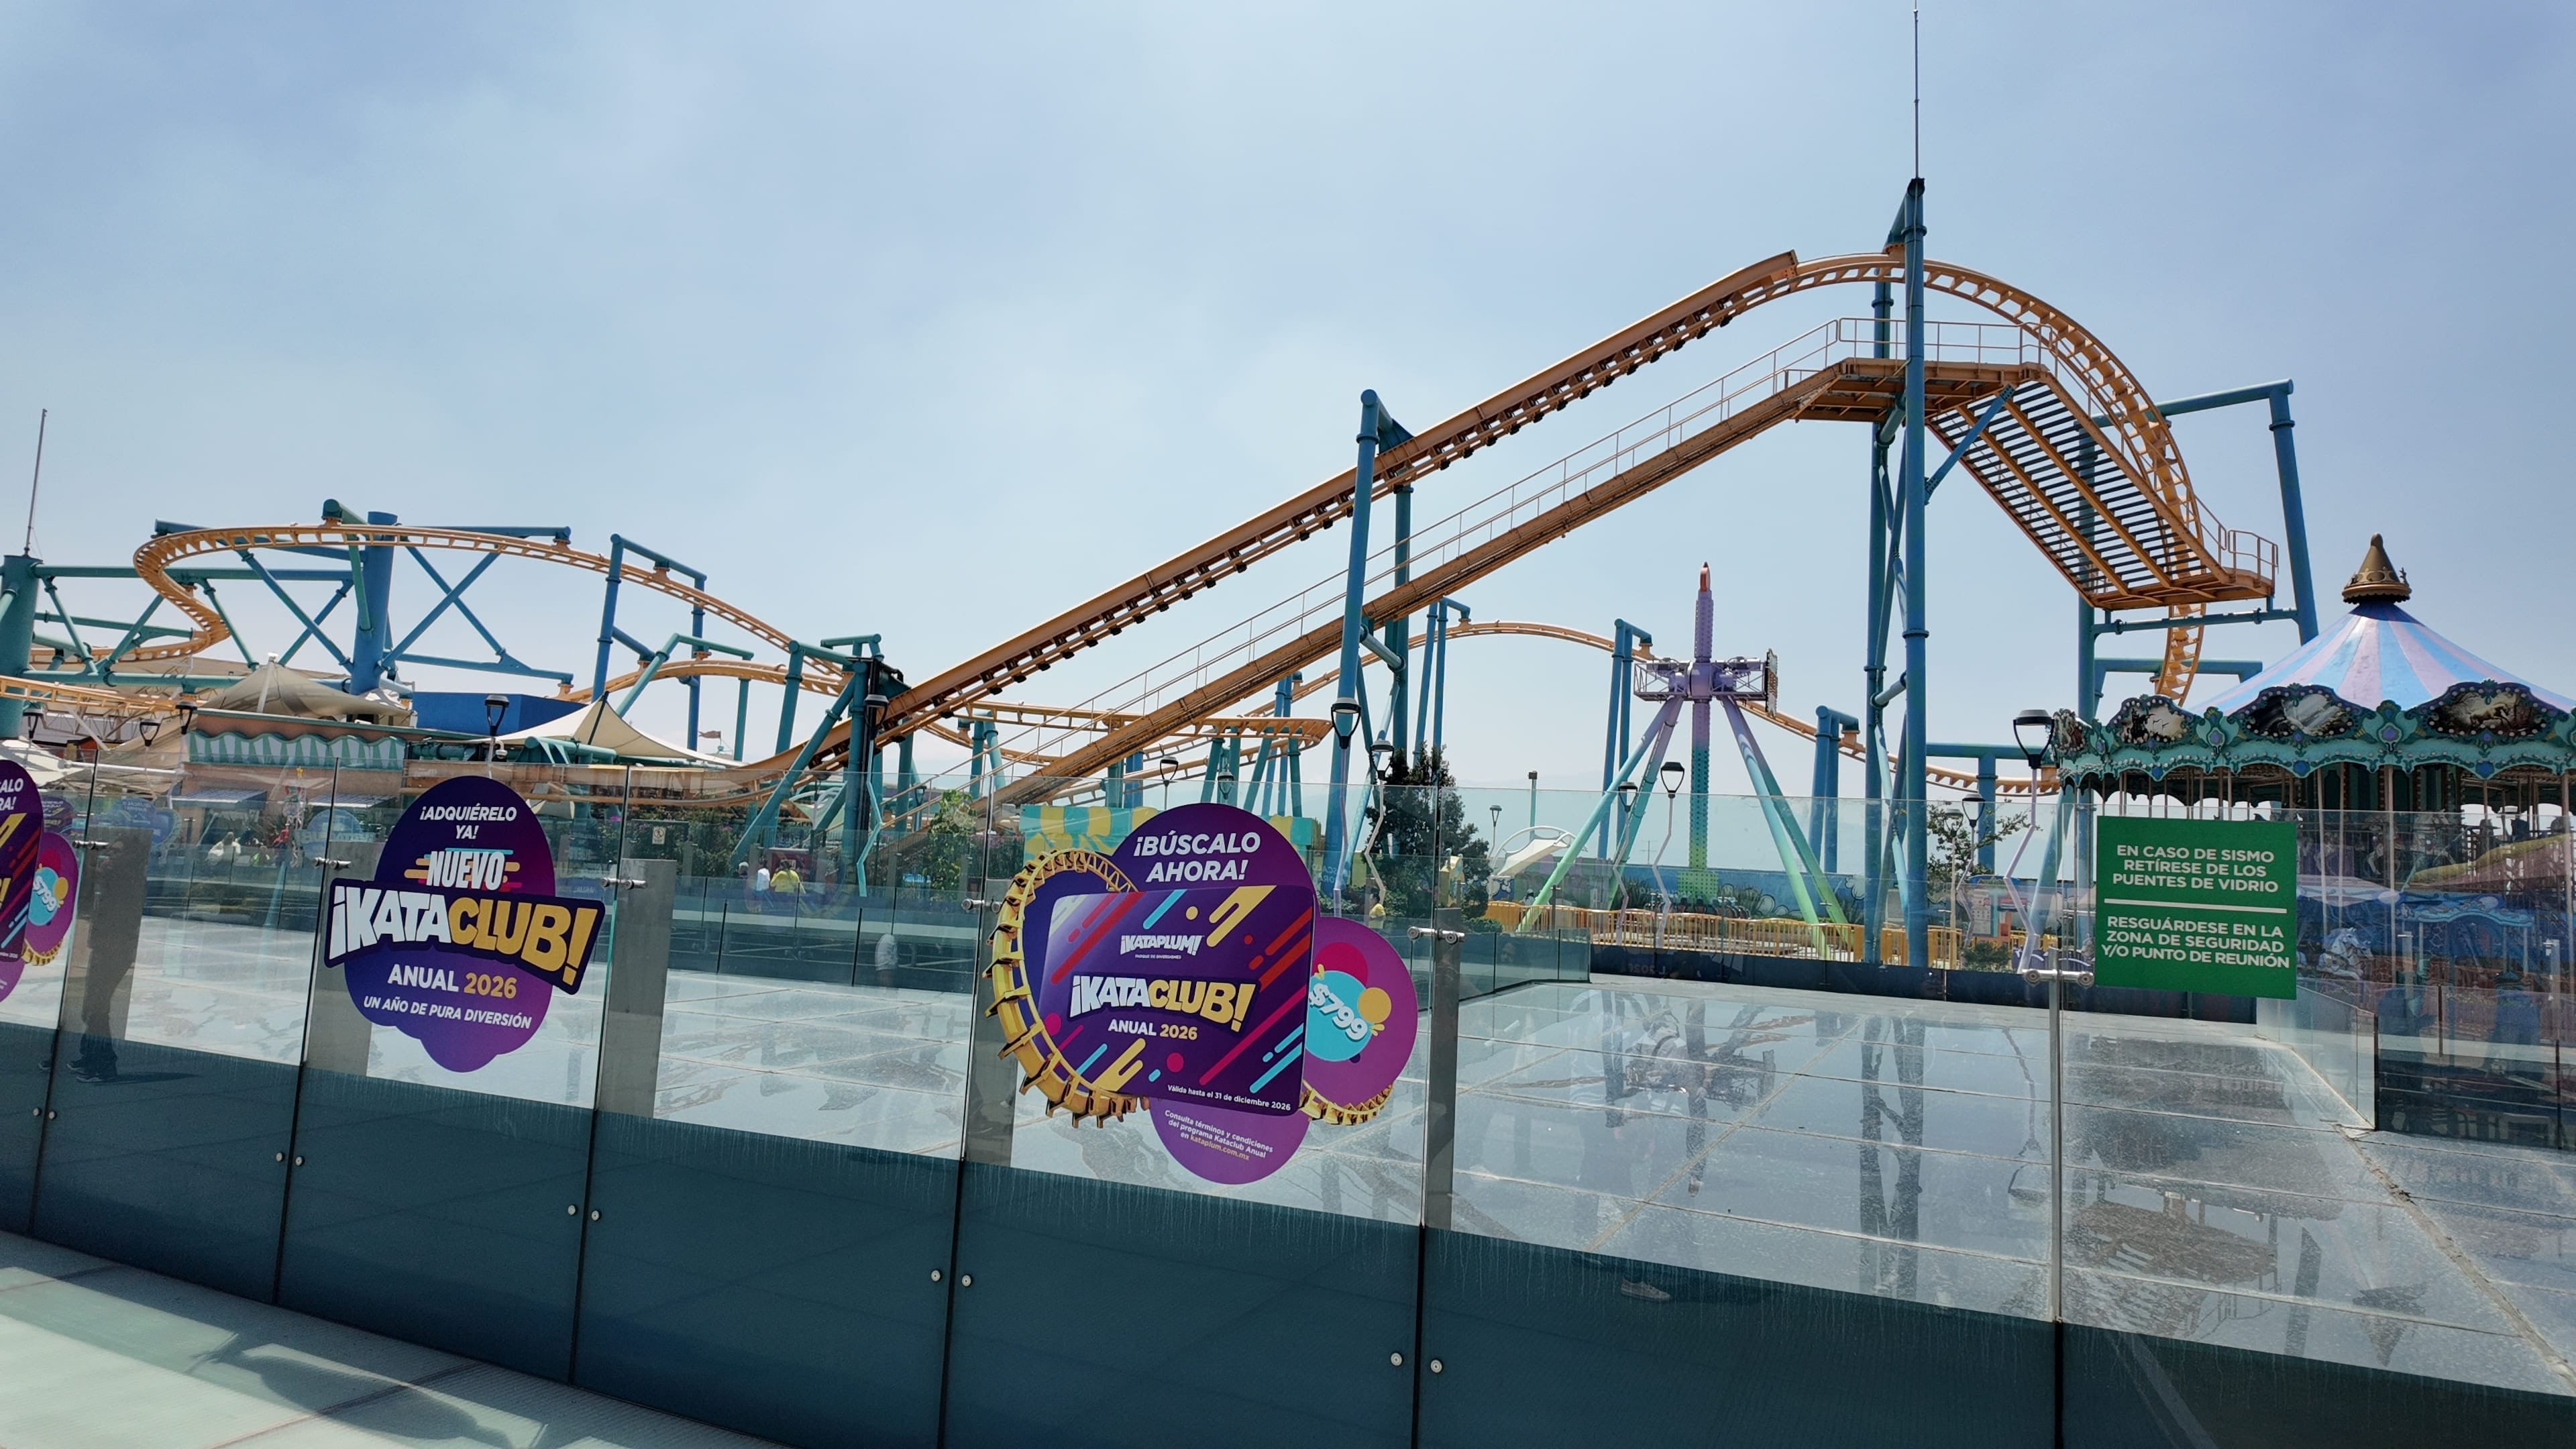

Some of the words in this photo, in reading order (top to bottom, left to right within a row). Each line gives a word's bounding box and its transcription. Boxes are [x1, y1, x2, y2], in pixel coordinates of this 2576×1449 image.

[419, 803, 517, 821] ¡ADQUIÉRELO
[455, 825, 480, 839] YA!
[1133, 830, 1261, 857] ¡BÚSCALO
[2117, 845, 2139, 857] EN
[2143, 845, 2190, 859] CASO
[2194, 848, 2217, 861] DE
[2220, 849, 2275, 863] SISMO
[426, 851, 505, 891] NUEVO
[1145, 859, 1248, 883] AHORA!
[2124, 859, 2202, 875] RETÍRESE
[2206, 863, 2229, 875] DE
[2233, 865, 2267, 877] LOS
[2113, 873, 2188, 888] PUENTES
[2191, 877, 2214, 890] DE
[2218, 879, 2279, 893] VIDRIO
[2107, 916, 2229, 934] RESGUÁRDESE
[2233, 924, 2257, 936] EN
[2261, 926, 2284, 938] LA
[1120, 935, 1202, 956] ¡KATAPLUM!
[2106, 930, 2154, 945] ZONA
[2158, 934, 2181, 946] DE
[2185, 935, 2285, 953] SEGURIDAD
[2101, 944, 2129, 958] Y/O
[2133, 946, 2187, 961] PUNTO
[2190, 950, 2212, 963] DE
[2215, 951, 2290, 969] REUNIÓN
[387, 963, 459, 992] ANUAL
[464, 973, 517, 999] 2026
[363, 996, 380, 1009] UN
[381, 998, 409, 1014] AÑO
[411, 1002, 427, 1016] DE
[428, 1004, 462, 1020] PURA
[464, 1008, 533, 1030] DIVERSIÓN
[1308, 983, 1368, 1042] $799
[1108, 1019, 1157, 1036] ANUAL
[1159, 1024, 1198, 1040] 2026
[1167, 1084, 1187, 1093] Válida
[1188, 1087, 1205, 1097] hasta
[1223, 1093, 1232, 1102] de
[1234, 1095, 1270, 1108] diciembre
[1271, 1101, 1291, 1111] 2026
[1165, 1110, 1194, 1125] Consulta
[1195, 1120, 1225, 1136] términos
[1232, 1133, 1273, 1153] condiciones
[1168, 1119, 1179, 1128] del
[1180, 1123, 1213, 1140] programa
[1214, 1134, 1244, 1150] Kataclub
[1245, 1147, 1267, 1159] Anual
[1180, 1132, 1189, 1140] en
[1190, 1134, 1250, 1161] kataplum.com.mx
